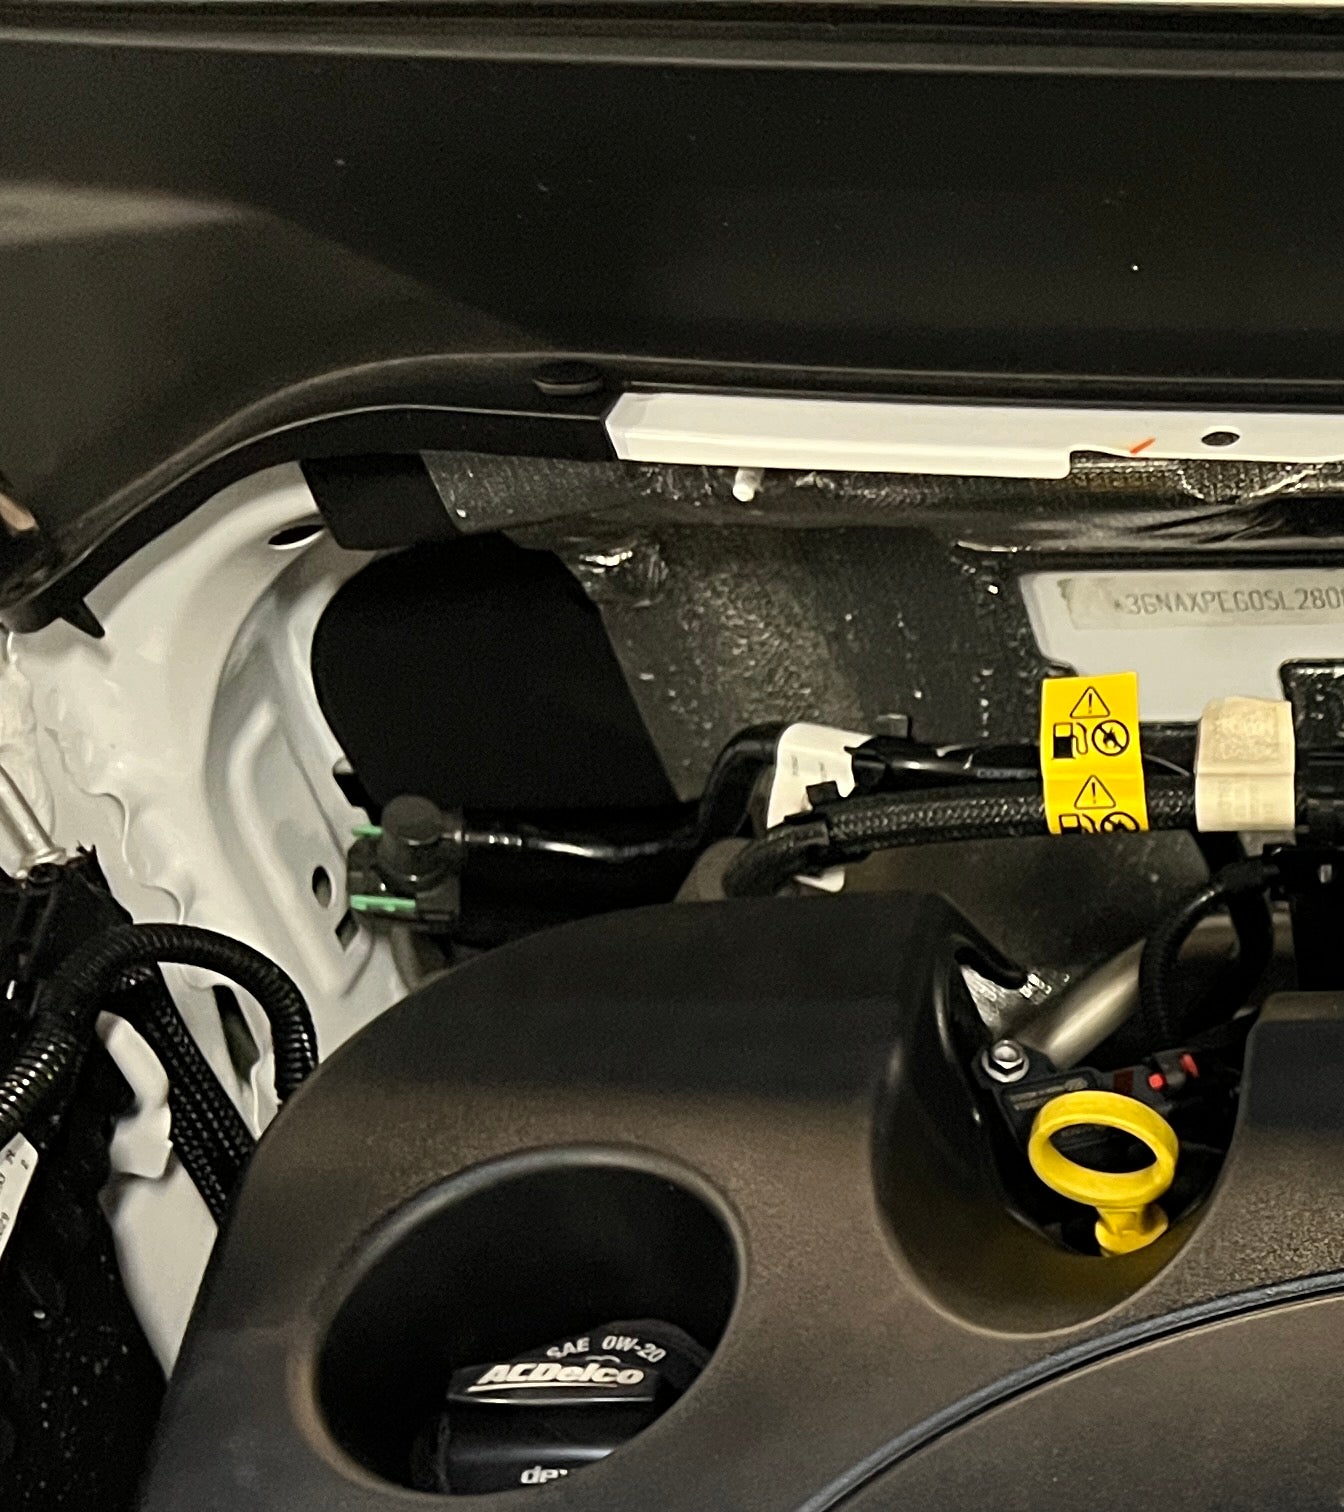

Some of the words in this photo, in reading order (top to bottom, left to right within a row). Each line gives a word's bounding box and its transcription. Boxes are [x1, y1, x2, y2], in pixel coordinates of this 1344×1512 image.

[546, 1337, 590, 1358] SAE
[602, 1335, 667, 1363] 0W-20
[476, 1363, 645, 1385] ACDelco
